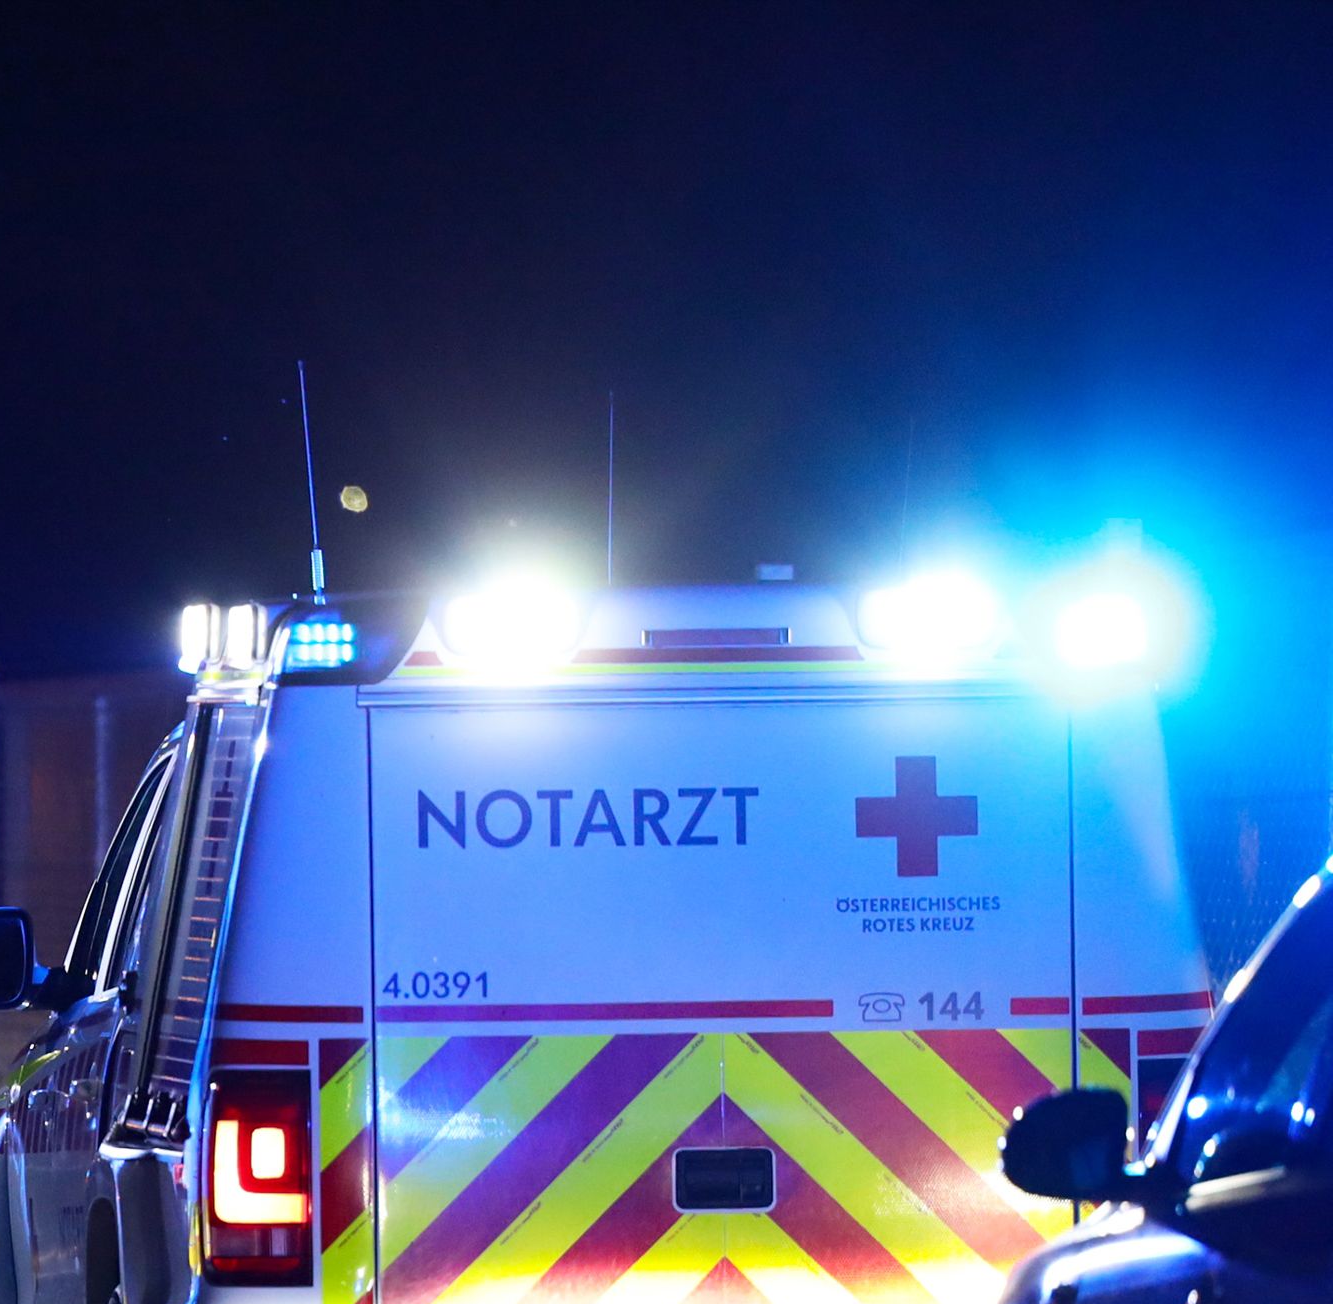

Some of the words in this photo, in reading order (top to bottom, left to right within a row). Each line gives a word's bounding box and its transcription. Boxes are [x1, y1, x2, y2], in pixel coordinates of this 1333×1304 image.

[417, 786, 759, 850] NOTARZT
[836, 896, 1001, 913] ÖSTERREICHISCHES
[862, 918, 915, 933] ROTES
[920, 917, 974, 931] KREUZ
[382, 971, 487, 999] 4.0391
[918, 991, 985, 1021] 144
